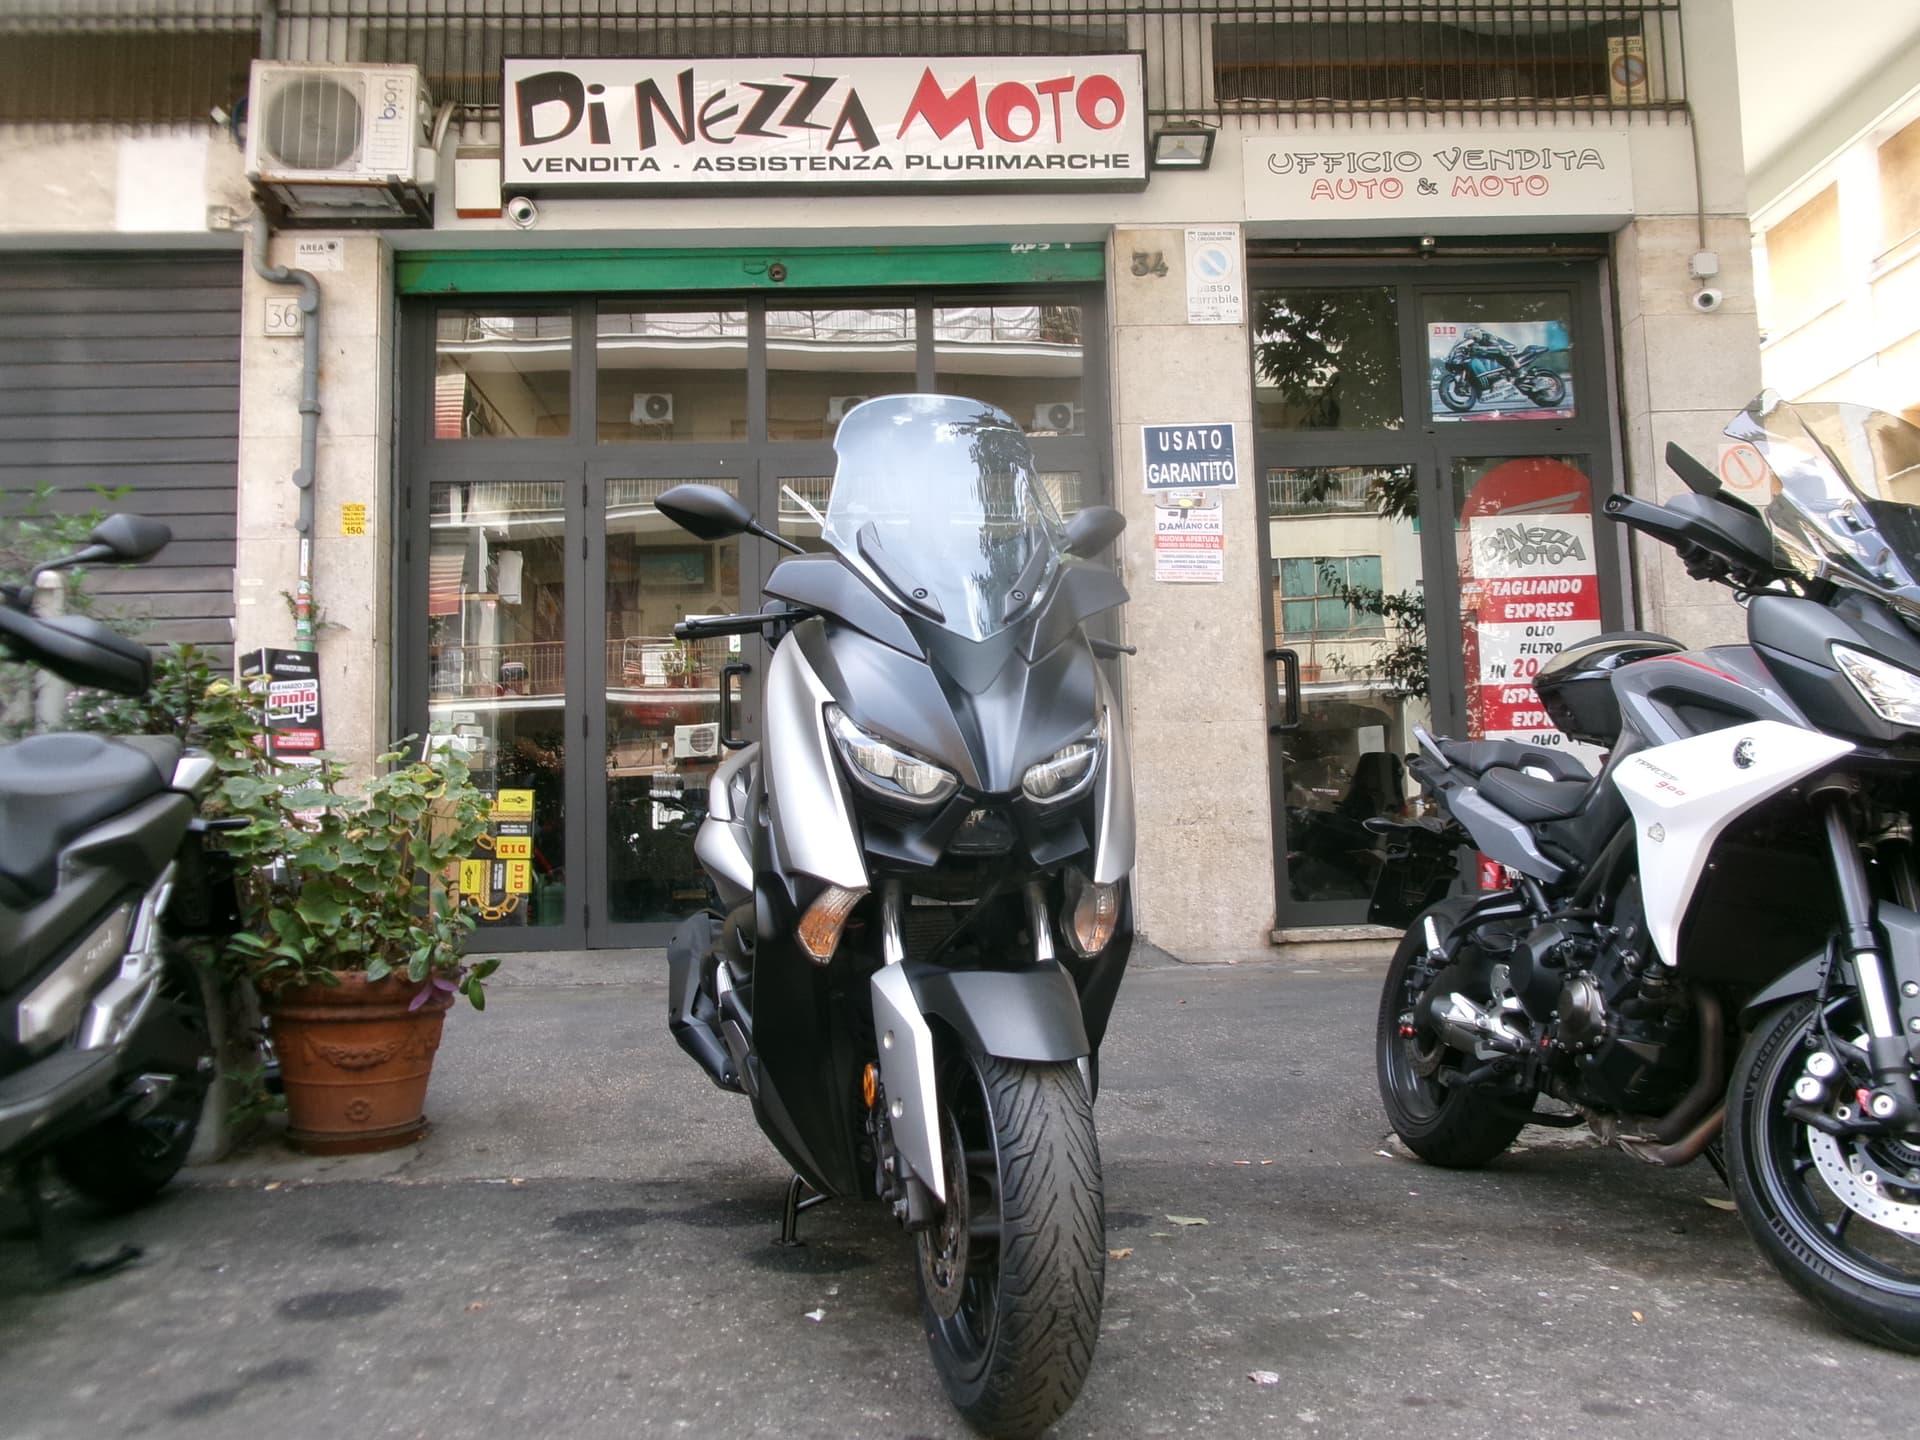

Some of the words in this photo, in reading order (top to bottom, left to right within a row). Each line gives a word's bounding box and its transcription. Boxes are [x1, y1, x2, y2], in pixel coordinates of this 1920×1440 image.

[896, 65, 1124, 150] MOTO
[521, 154, 661, 173] VENDITA
[691, 154, 893, 173] ASSISTENZA
[904, 153, 1130, 171] PLURIMARCHE
[1267, 150, 1422, 174] UFFICIO
[1433, 146, 1605, 171] VENDITA
[1311, 177, 1404, 200] AUTO
[1416, 178, 1439, 195] &
[1452, 175, 1549, 198] MOTO
[1131, 250, 1169, 278] 34
[268, 303, 299, 329] 36
[1158, 429, 1223, 452] USATO
[1148, 460, 1234, 484] GARANTITO
[1158, 522, 1203, 531] DAMIANO
[1204, 522, 1219, 530] CAR
[1491, 578, 1582, 596] TAGLIANDO
[1504, 601, 1575, 619] EXPRESS
[1525, 625, 1555, 637] OLIO
[1519, 642, 1562, 654] FILTRO
[1512, 657, 1539, 678] 20
[271, 689, 316, 705] moto
[1531, 734, 1561, 746] OLIO
[1655, 780, 1687, 796] 900
